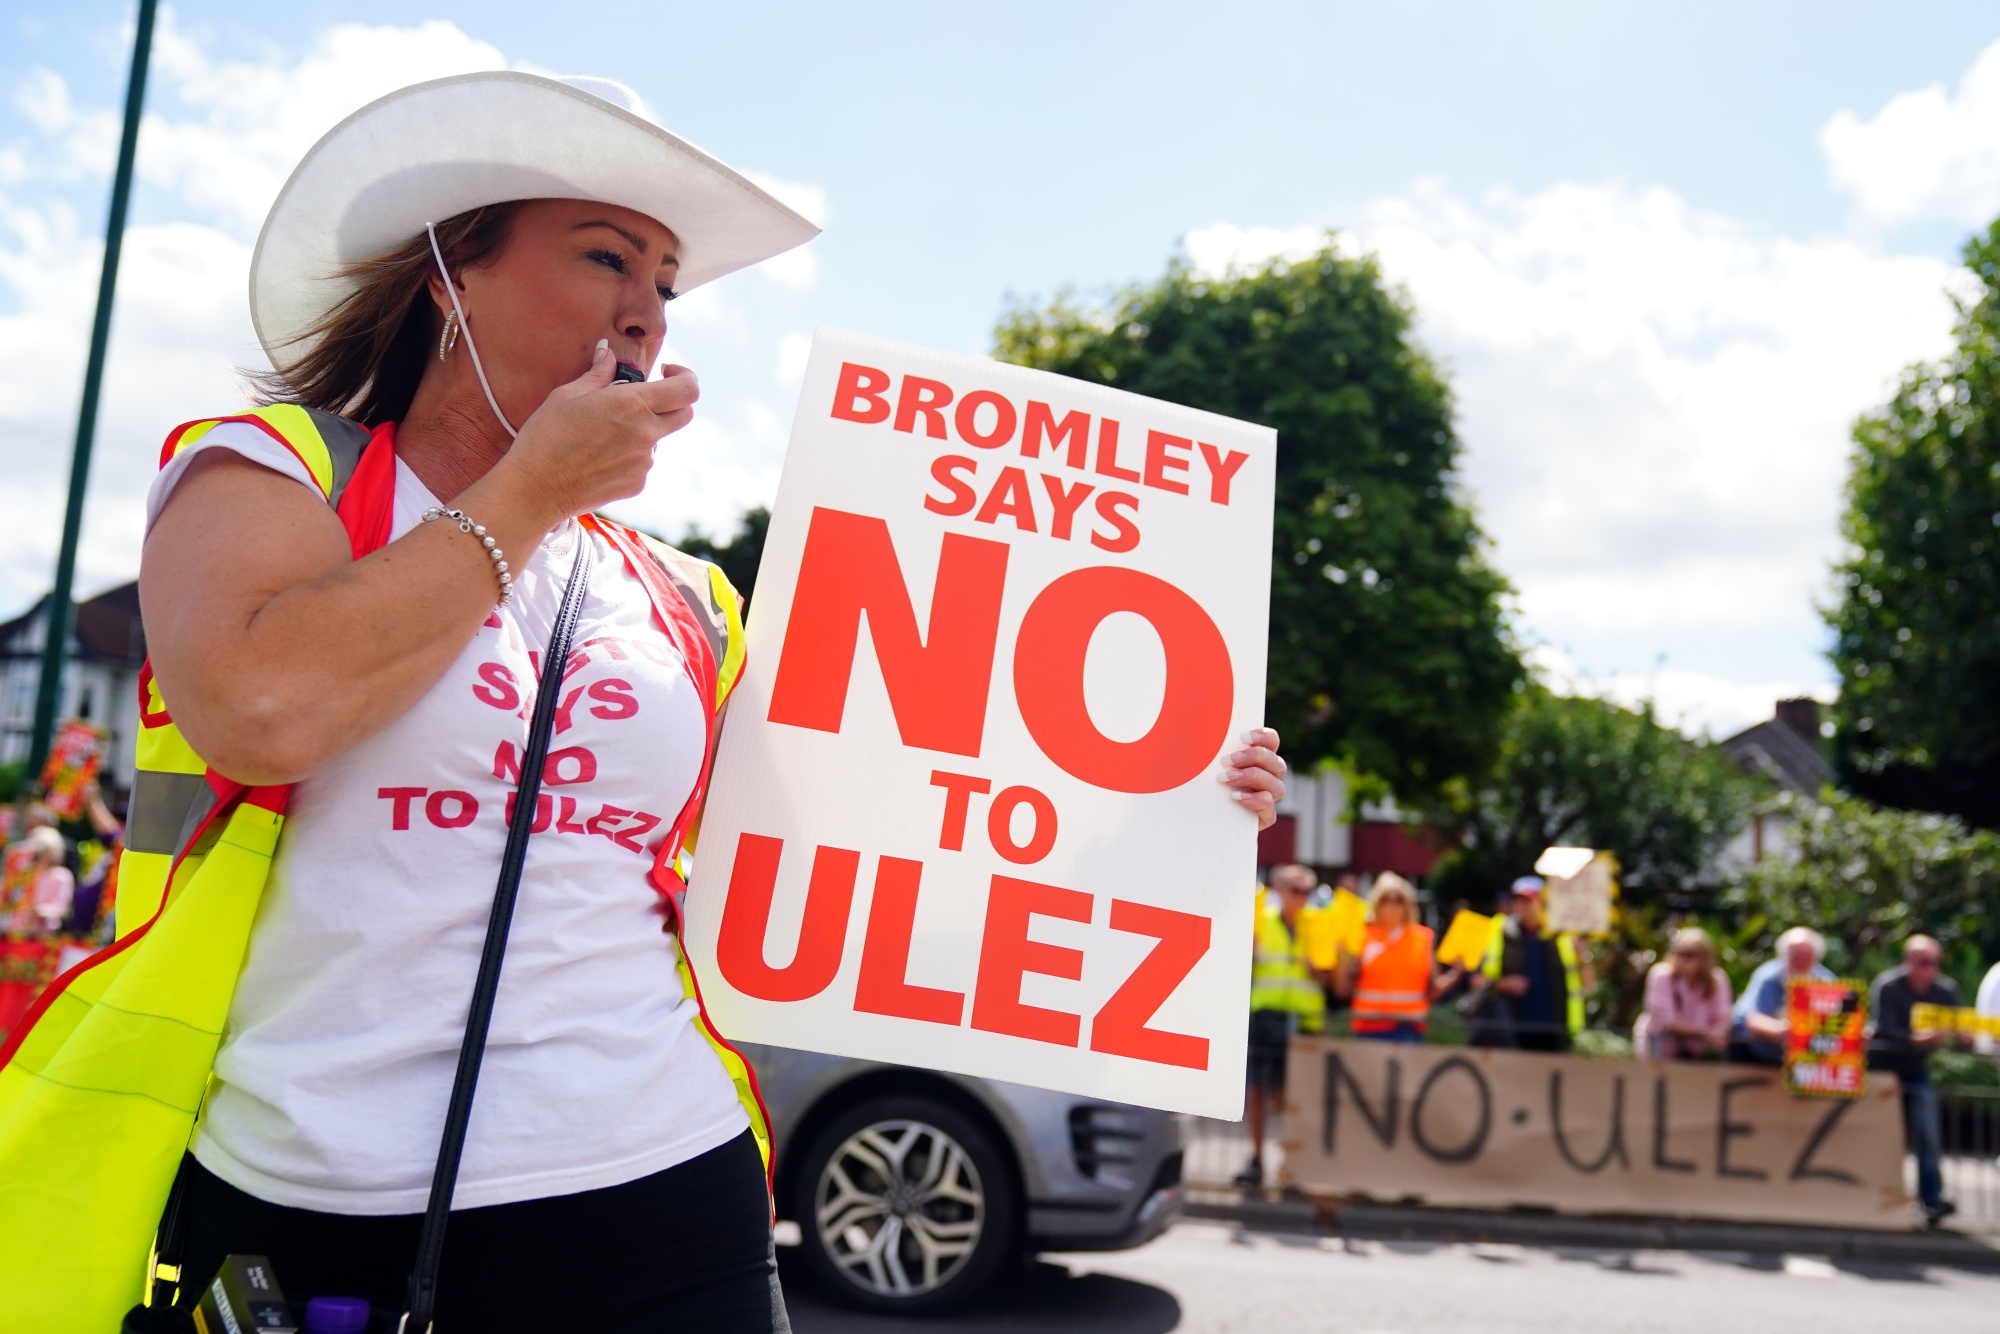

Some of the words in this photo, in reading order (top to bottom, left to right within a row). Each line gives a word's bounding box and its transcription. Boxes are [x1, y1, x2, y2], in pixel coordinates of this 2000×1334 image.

[830, 361, 1250, 506] BROMLEY
[923, 454, 1141, 553] SAYS
[767, 506, 1234, 794] NO
[492, 740, 597, 787] NO
[377, 786, 479, 831] TO
[505, 792, 661, 854] ULEZ
[929, 769, 1058, 864] TO
[716, 832, 1212, 1071] ULEZ
[1322, 1050, 1493, 1165] NO
[1547, 1069, 1867, 1187] ULEZ
[1793, 1062, 1858, 1092] MILE
